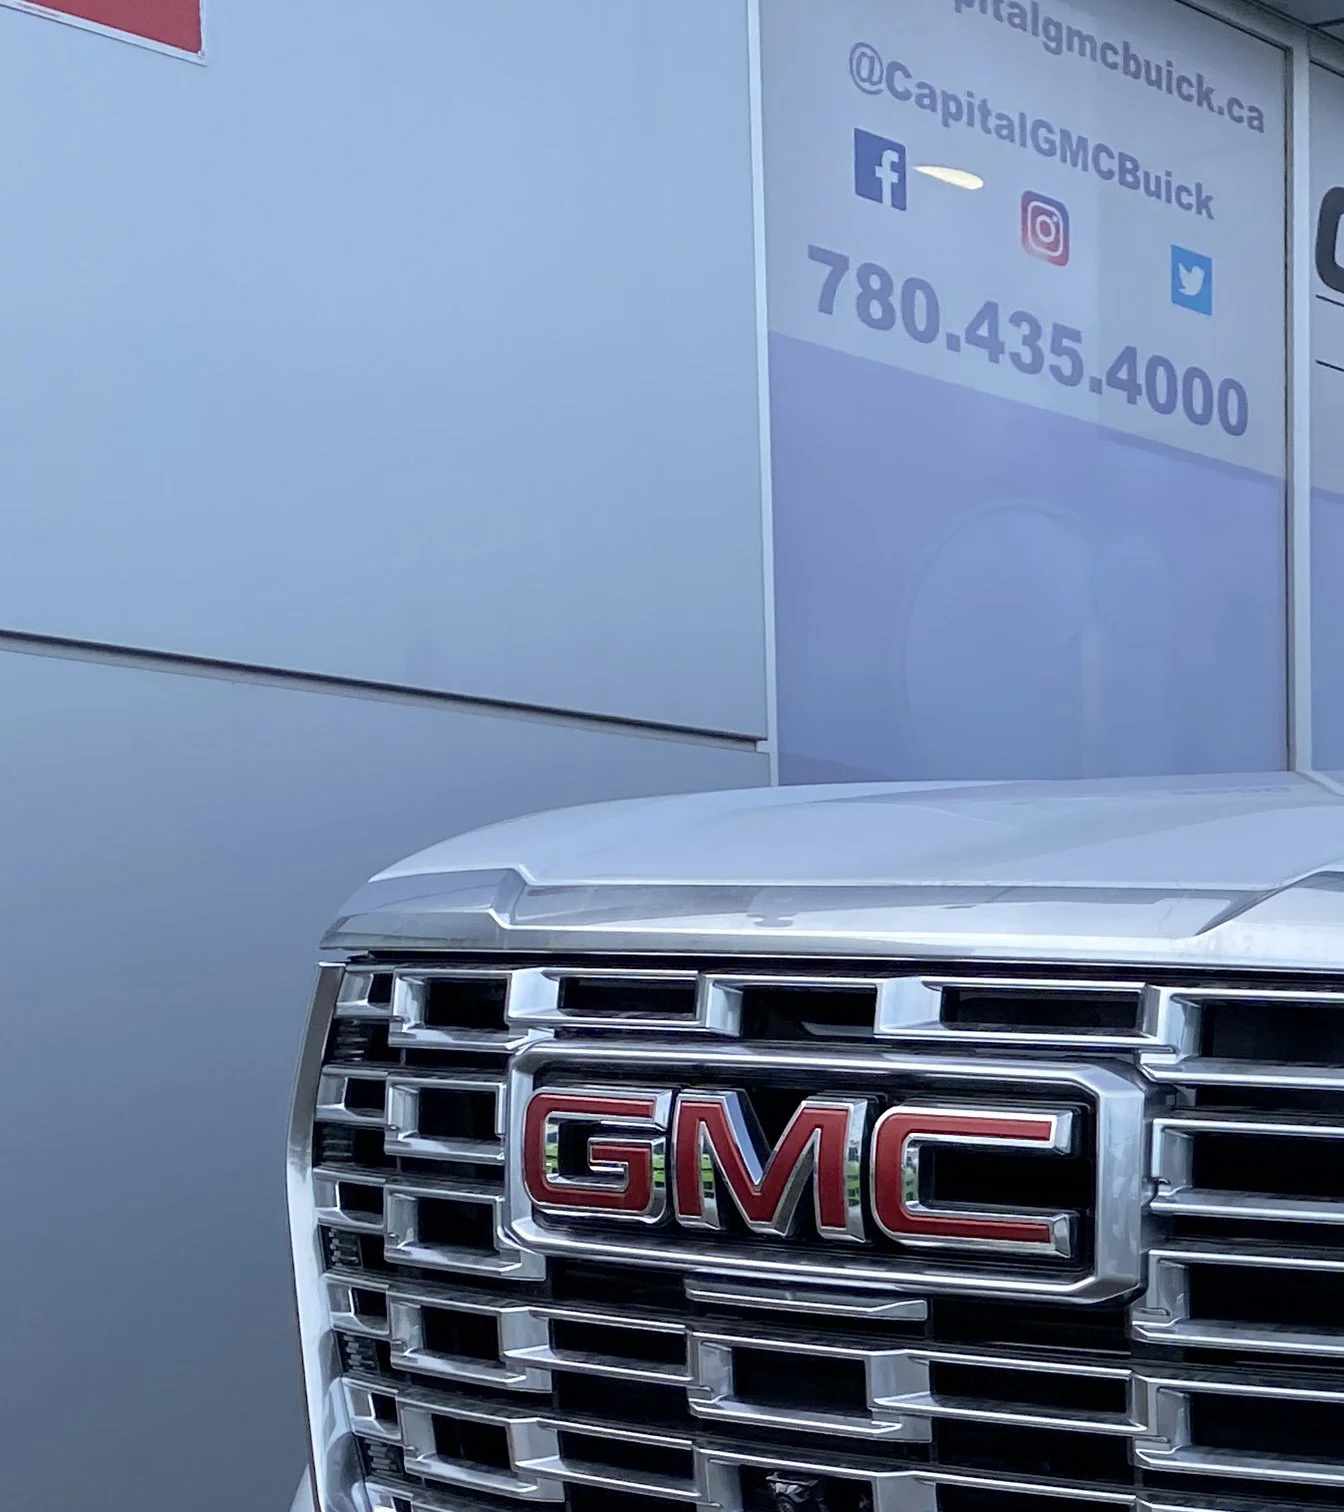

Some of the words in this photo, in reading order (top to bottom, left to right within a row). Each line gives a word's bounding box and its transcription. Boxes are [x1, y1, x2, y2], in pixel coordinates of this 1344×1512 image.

[849, 42, 1216, 220] @CapitalGMCBuick
[807, 245, 1249, 437] 780.435.4000
[522, 1084, 1077, 1260] GMC
